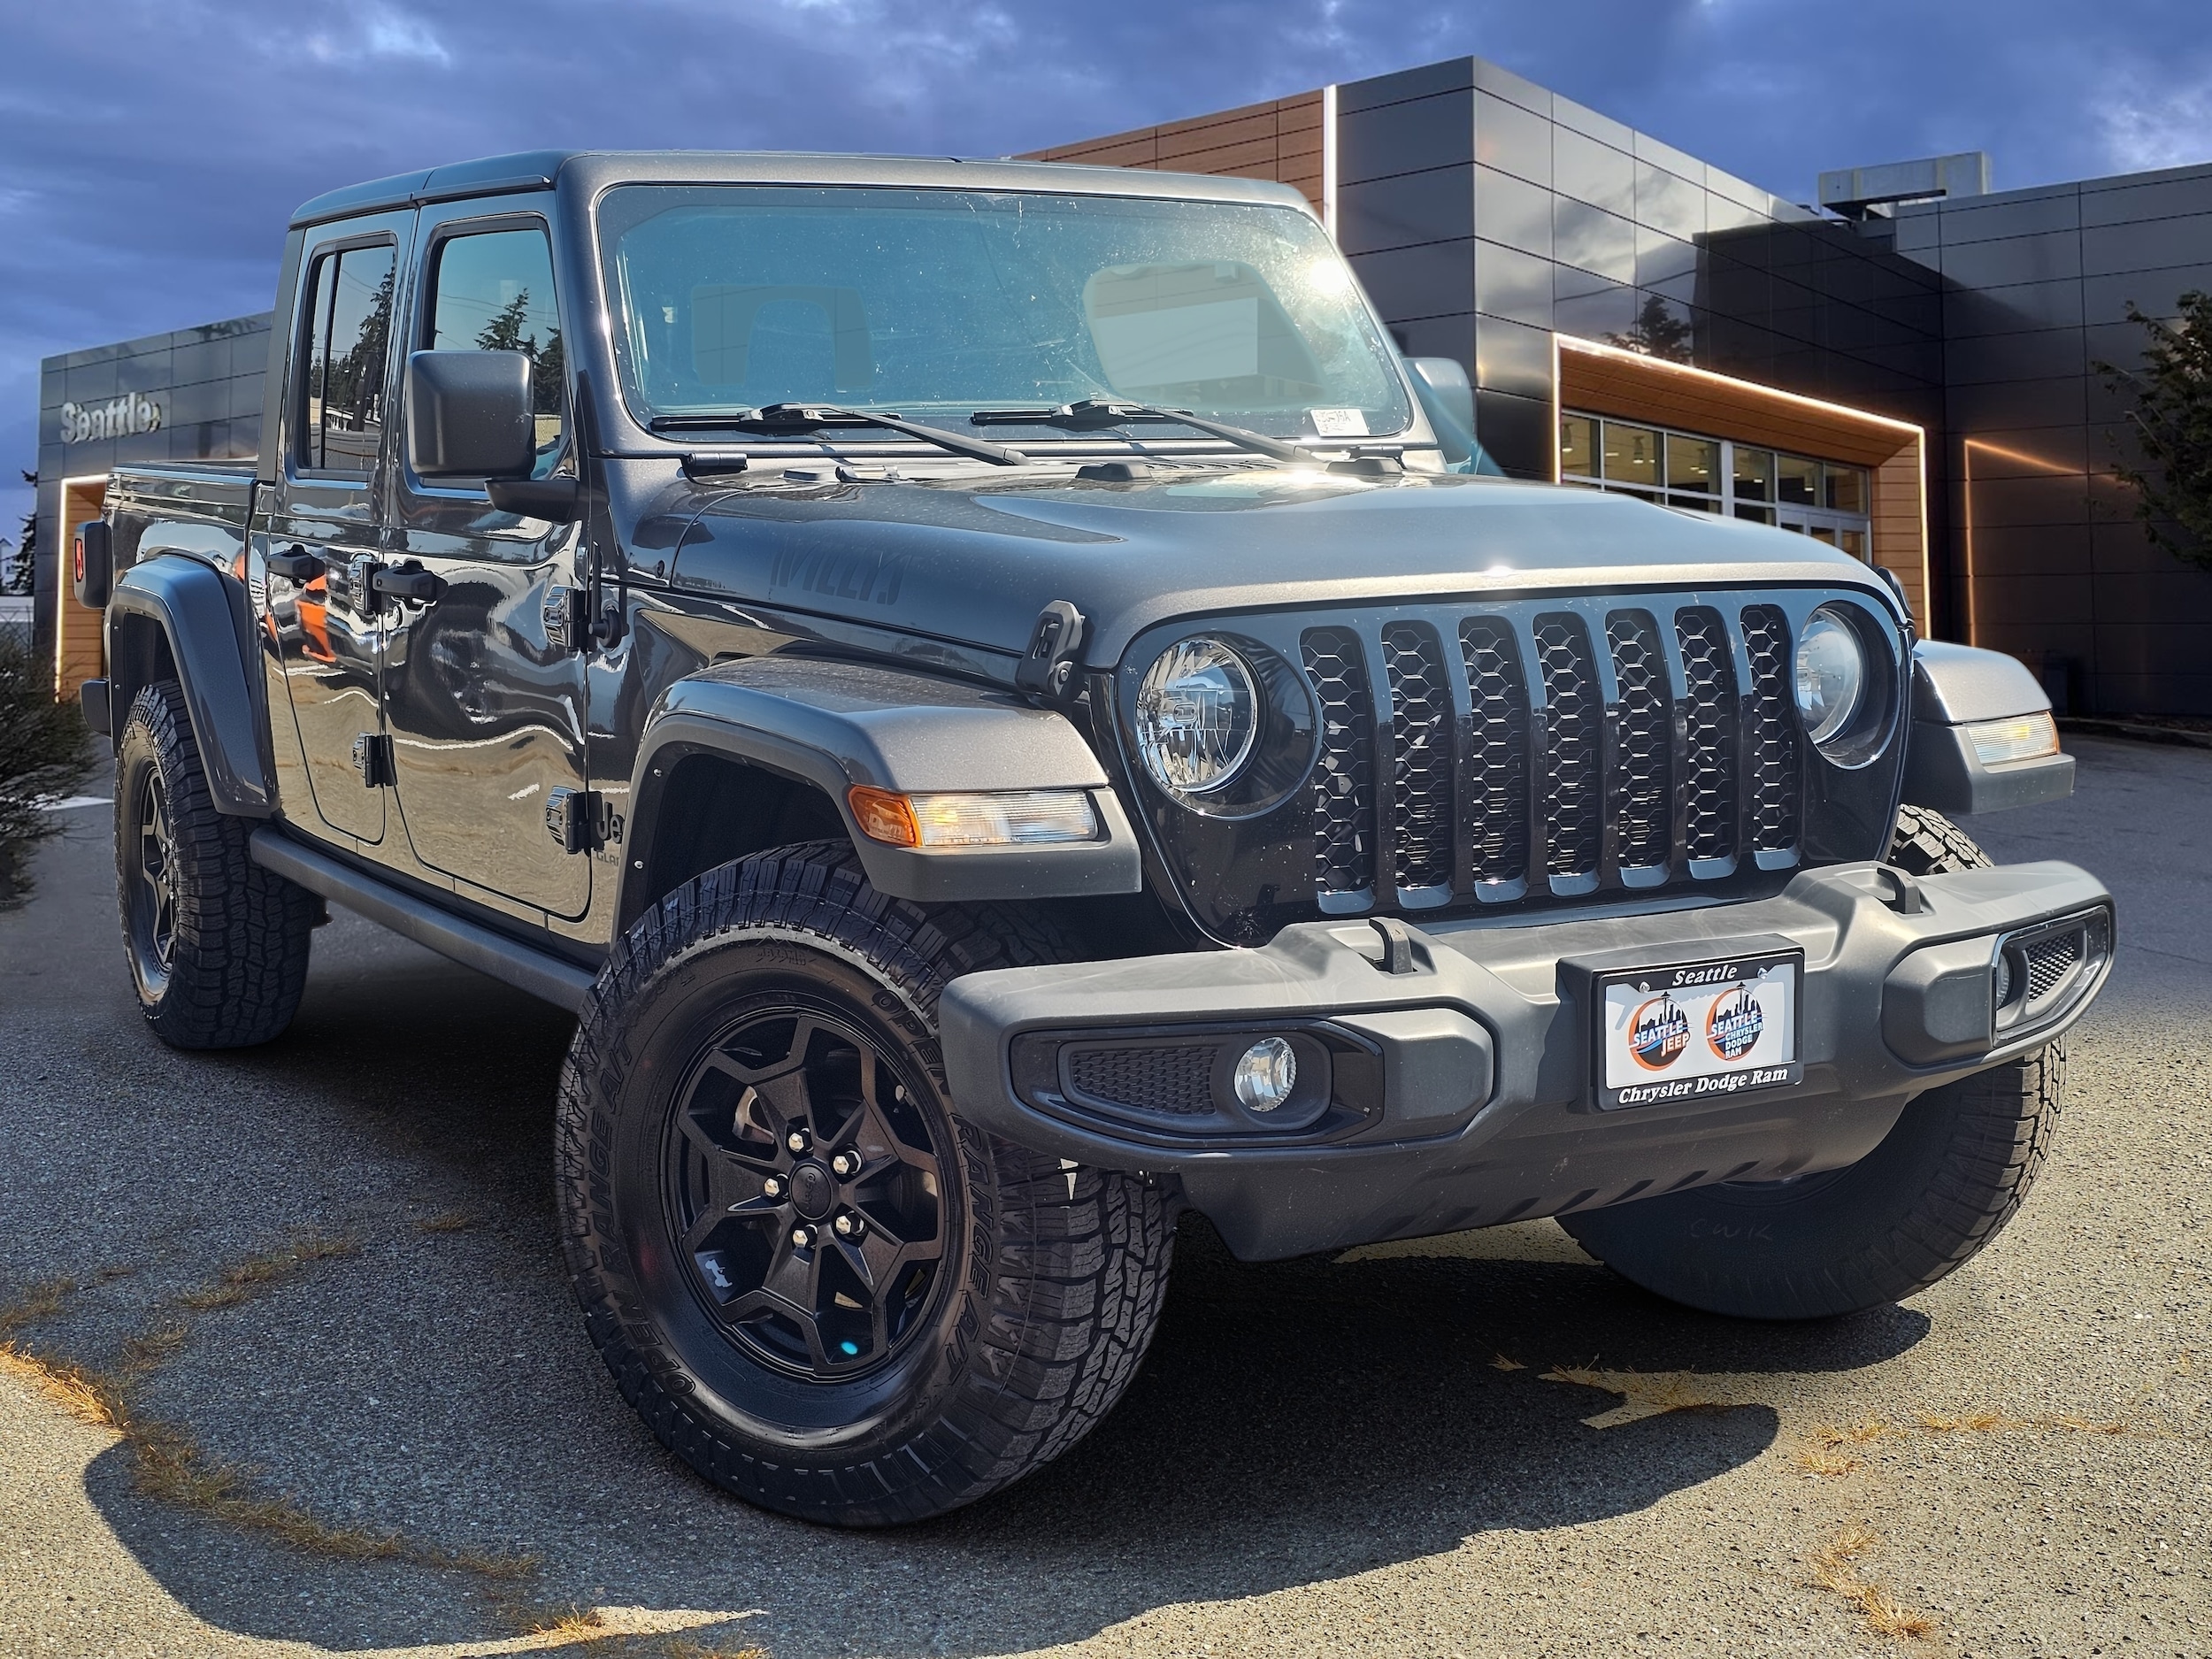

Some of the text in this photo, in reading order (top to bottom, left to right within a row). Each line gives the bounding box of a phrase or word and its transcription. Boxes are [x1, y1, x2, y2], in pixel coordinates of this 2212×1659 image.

[59, 392, 159, 443] Seattle
[595, 802, 625, 844] Je
[1671, 964, 1739, 987] Seattle
[1632, 1019, 1684, 1048] SEATTLE
[1710, 1009, 1758, 1038] SEATTLE
[1724, 1021, 1764, 1042] CHRYSLER
[1660, 1030, 1691, 1057] JEEP
[1724, 1033, 1754, 1051] DODGE
[1724, 1046, 1742, 1060] RAM
[1617, 1067, 1788, 1104] Chrysler Dodge Ram
[587, 1026, 695, 1396] OPEN RANGE A/T
[947, 1113, 996, 1301] RANGE
